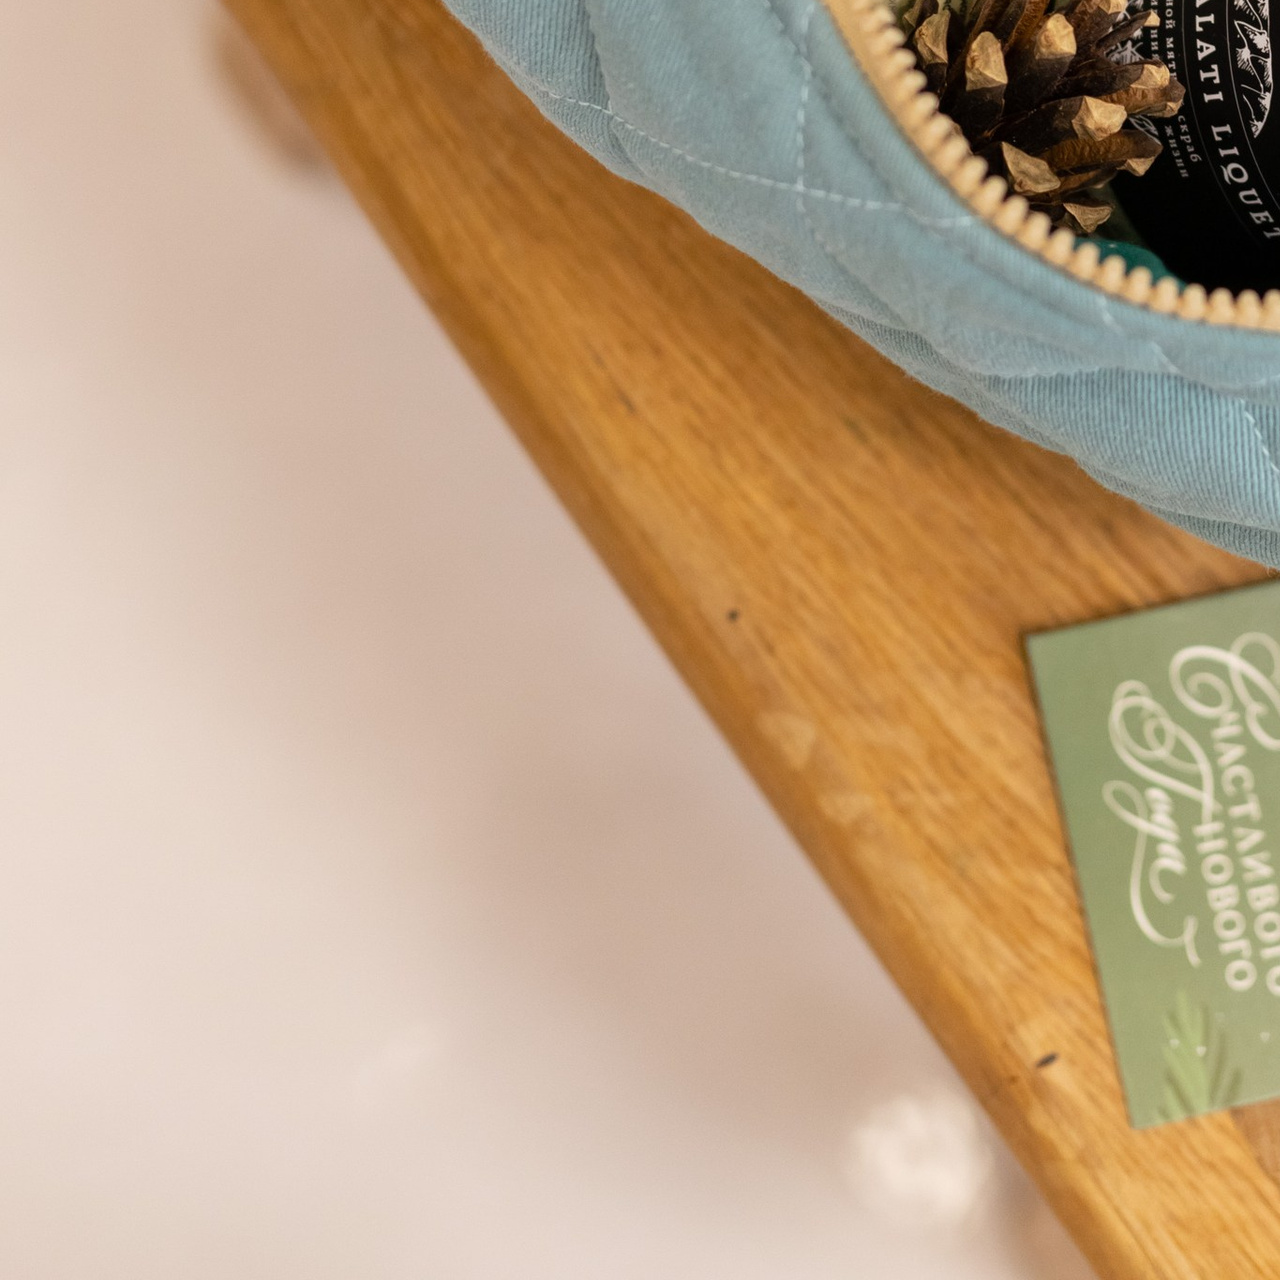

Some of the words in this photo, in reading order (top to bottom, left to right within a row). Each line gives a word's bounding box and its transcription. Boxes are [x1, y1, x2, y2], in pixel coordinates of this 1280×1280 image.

[1165, 125, 1189, 178] жизни
[1178, 115, 1202, 162] скраб
[1102, 680, 1215, 967] Года
